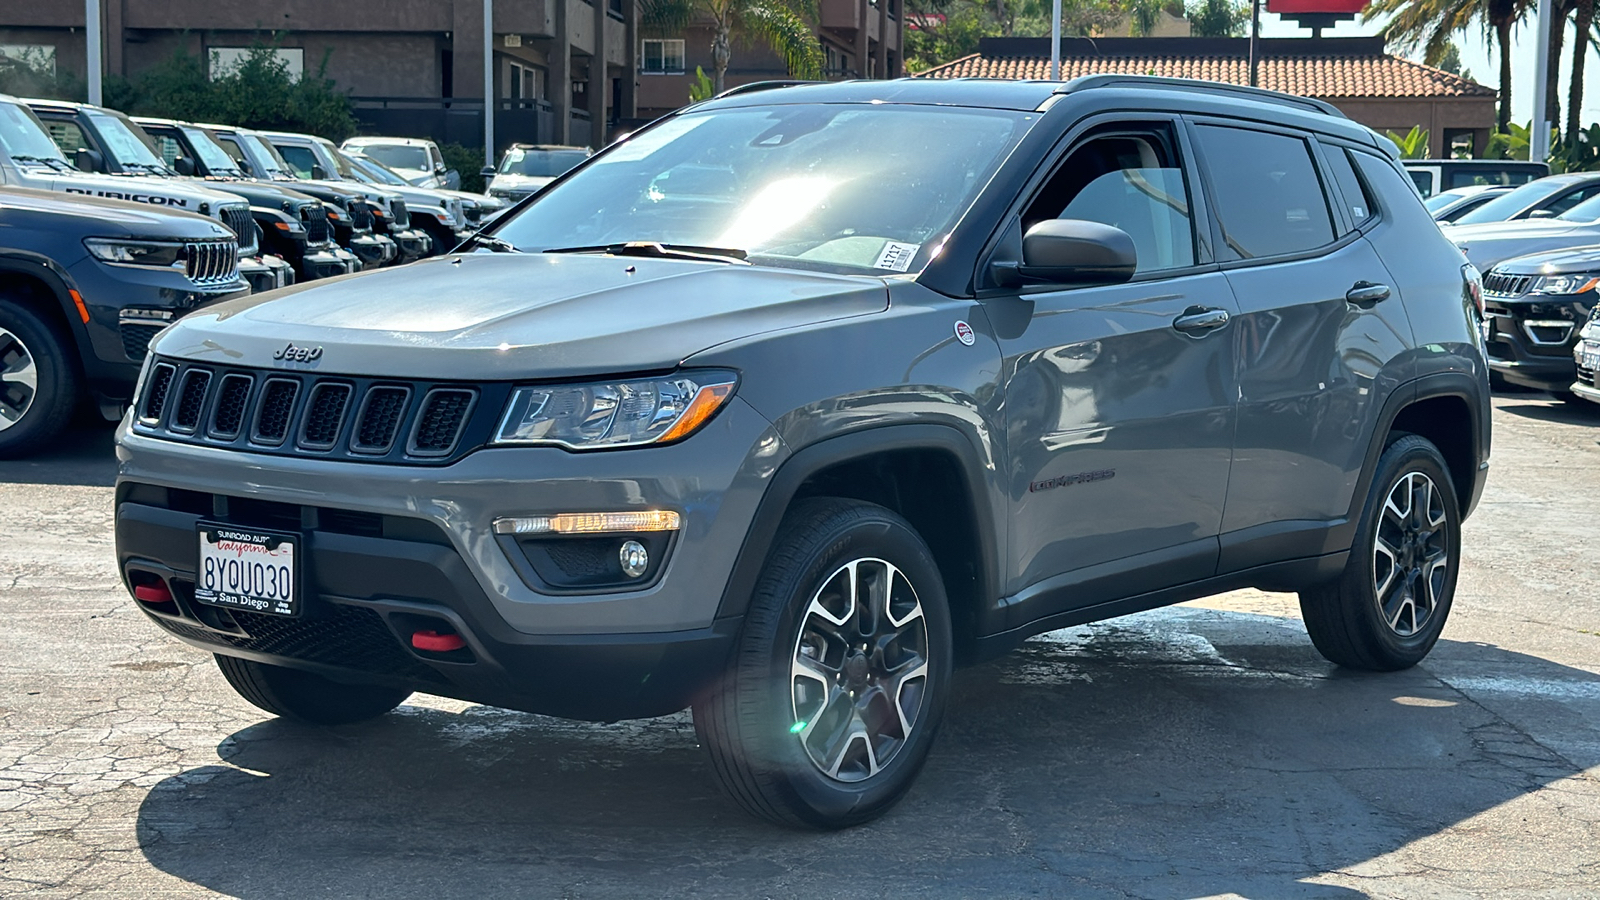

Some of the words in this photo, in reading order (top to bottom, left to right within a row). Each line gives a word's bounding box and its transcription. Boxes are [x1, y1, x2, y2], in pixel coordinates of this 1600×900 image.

[880, 244, 902, 269] 11717
[273, 342, 324, 364] Jeep
[1029, 468, 1116, 493] COMPASS
[217, 530, 252, 542] SUNROAD
[204, 556, 291, 601] 8YQU030
[219, 592, 238, 604] San
[240, 595, 269, 610] Diego
